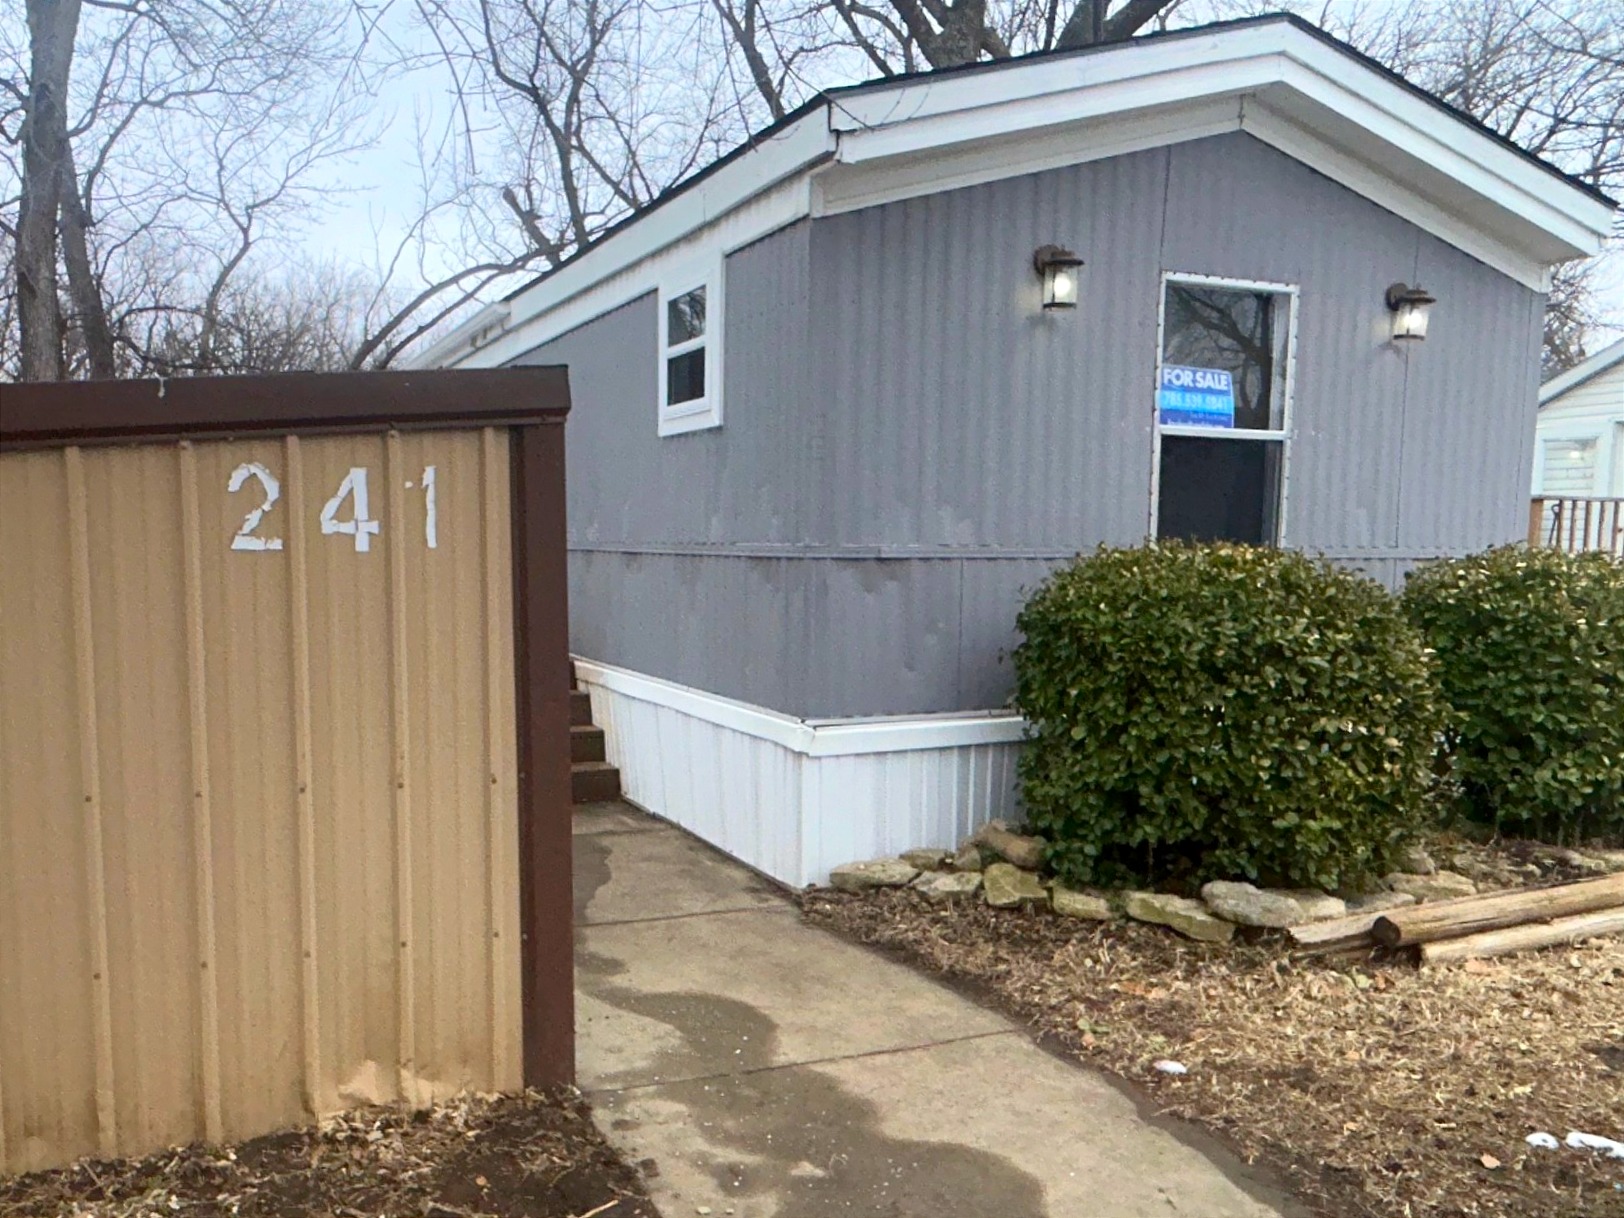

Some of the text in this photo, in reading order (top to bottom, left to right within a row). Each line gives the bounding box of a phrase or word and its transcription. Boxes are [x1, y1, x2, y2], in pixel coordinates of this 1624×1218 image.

[1163, 368, 1228, 391] FOR SALE
[227, 462, 437, 552] 241
